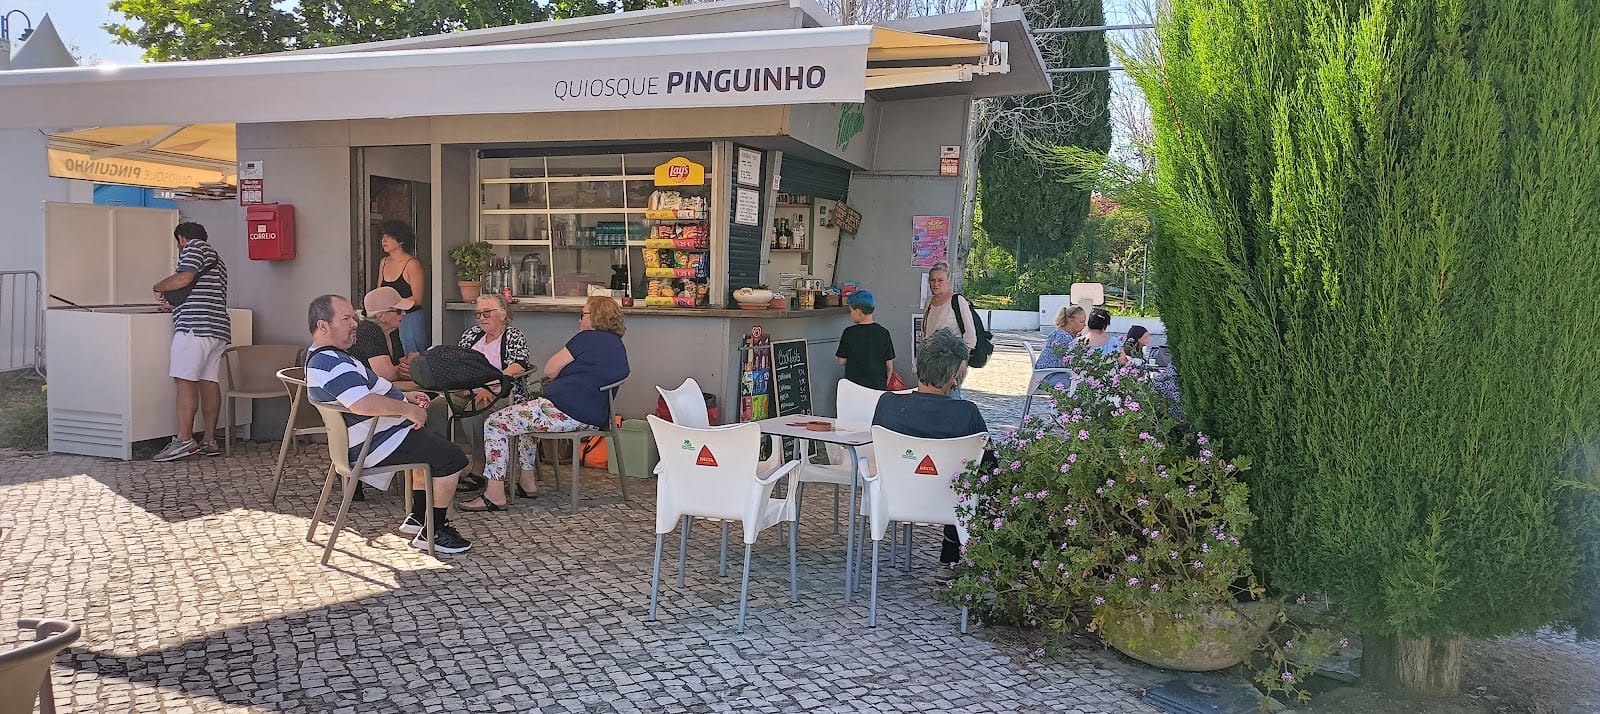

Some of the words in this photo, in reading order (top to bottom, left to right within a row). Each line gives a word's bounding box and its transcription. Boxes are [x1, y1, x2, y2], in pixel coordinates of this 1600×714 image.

[554, 77, 660, 100] QUIOSQUE
[666, 65, 826, 95] PINGUINHO
[669, 164, 690, 178] Lay's
[249, 232, 276, 240] CORREIO
